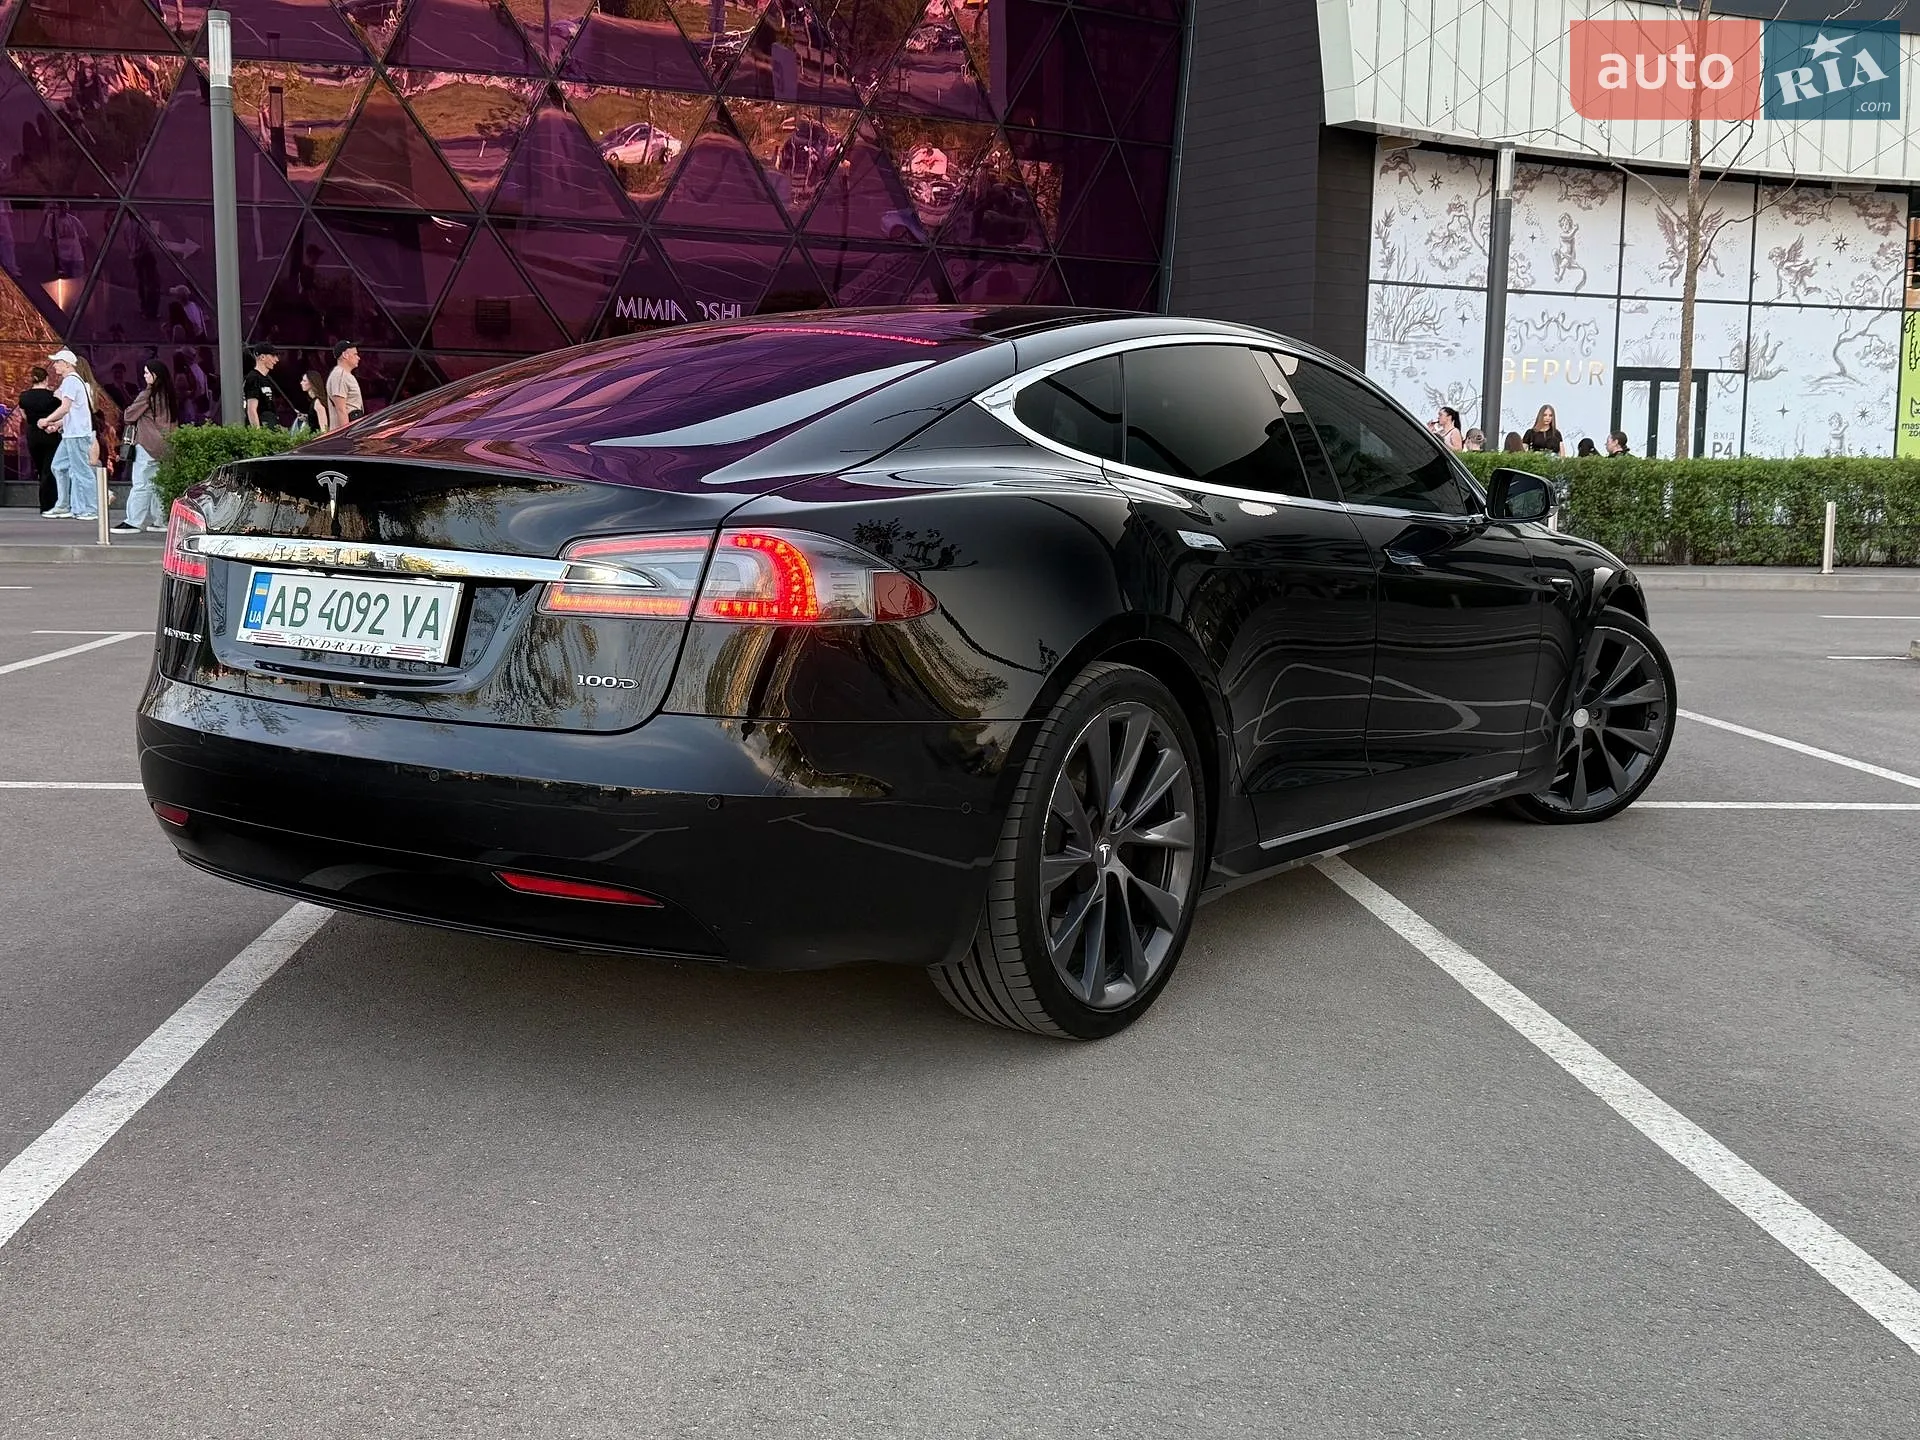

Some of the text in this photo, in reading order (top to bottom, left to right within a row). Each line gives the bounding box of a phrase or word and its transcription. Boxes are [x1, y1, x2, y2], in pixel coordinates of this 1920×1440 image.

[1503, 358, 1605, 386] GEPUR
[1711, 441, 1733, 460] P4
[249, 610, 262, 625] UA
[265, 585, 440, 641] AB 4092 YA
[192, 633, 202, 643] S
[291, 635, 384, 656] ANDRIVE
[576, 674, 640, 689] 100D
